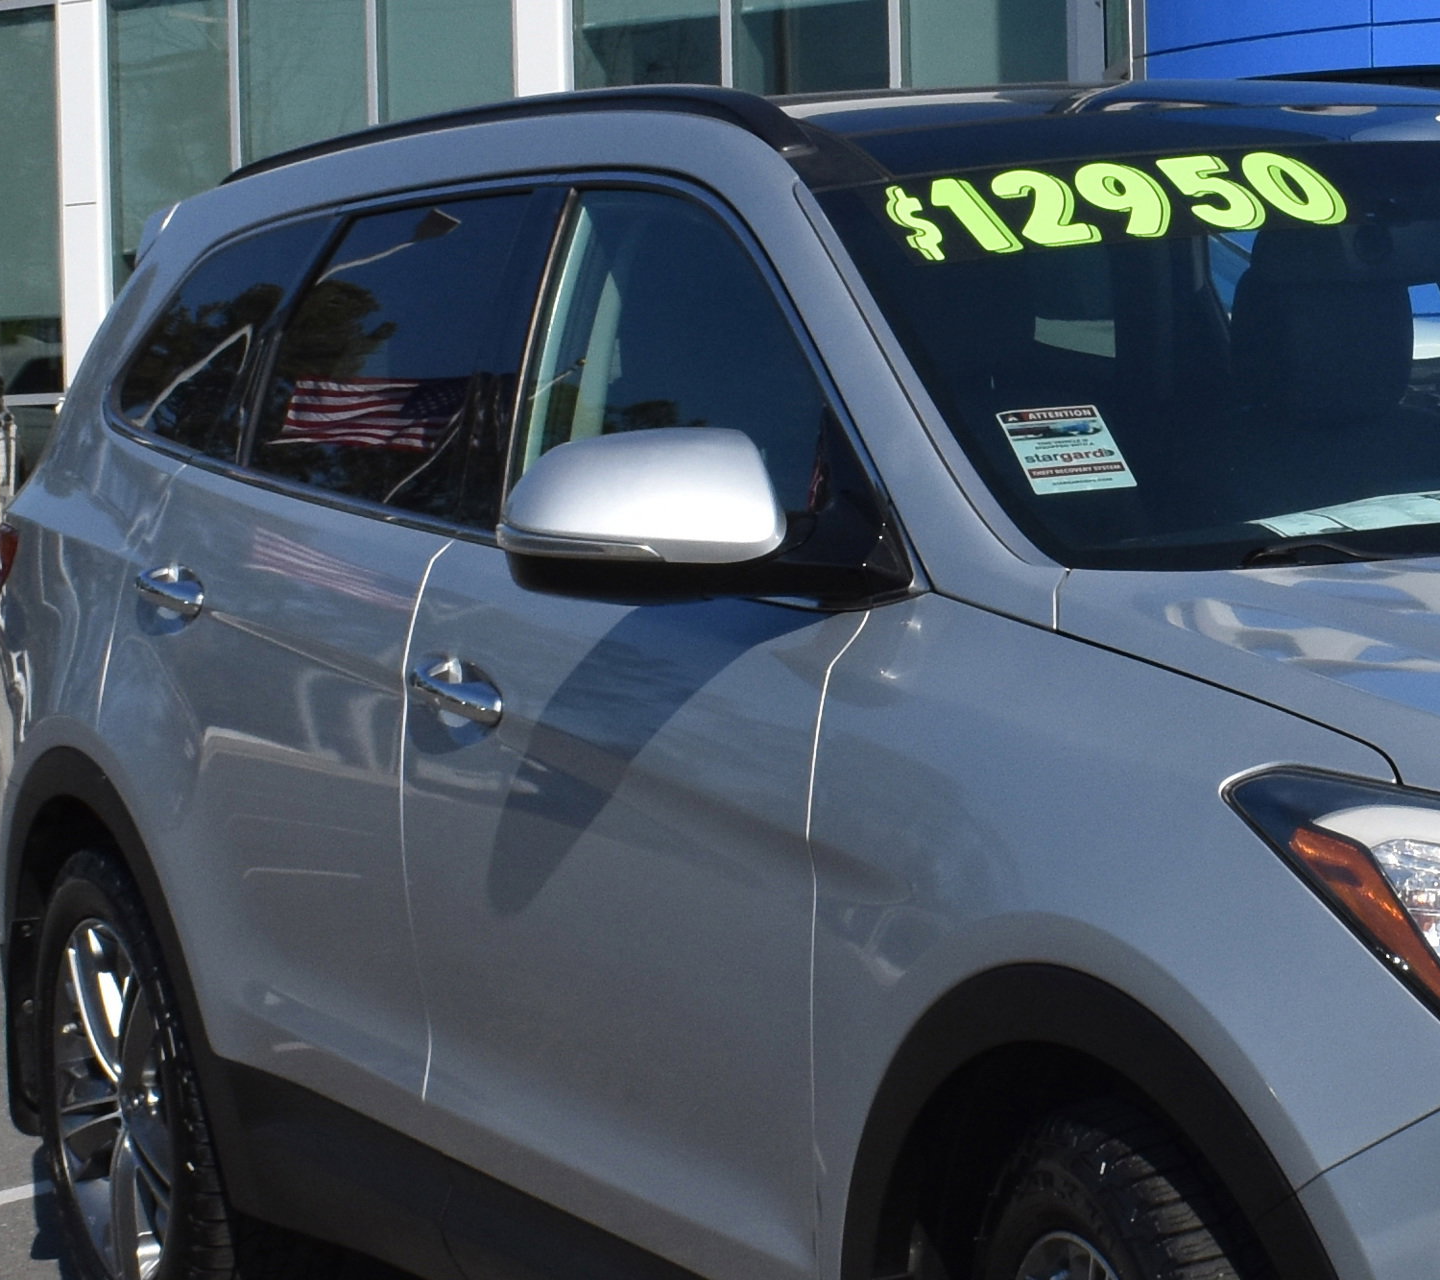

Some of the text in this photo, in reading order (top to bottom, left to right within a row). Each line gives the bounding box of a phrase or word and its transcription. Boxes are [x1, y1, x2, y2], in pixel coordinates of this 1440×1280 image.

[885, 151, 1348, 262] $12950
[1027, 409, 1092, 421] ATTENTION
[1024, 448, 1105, 464] stargard
